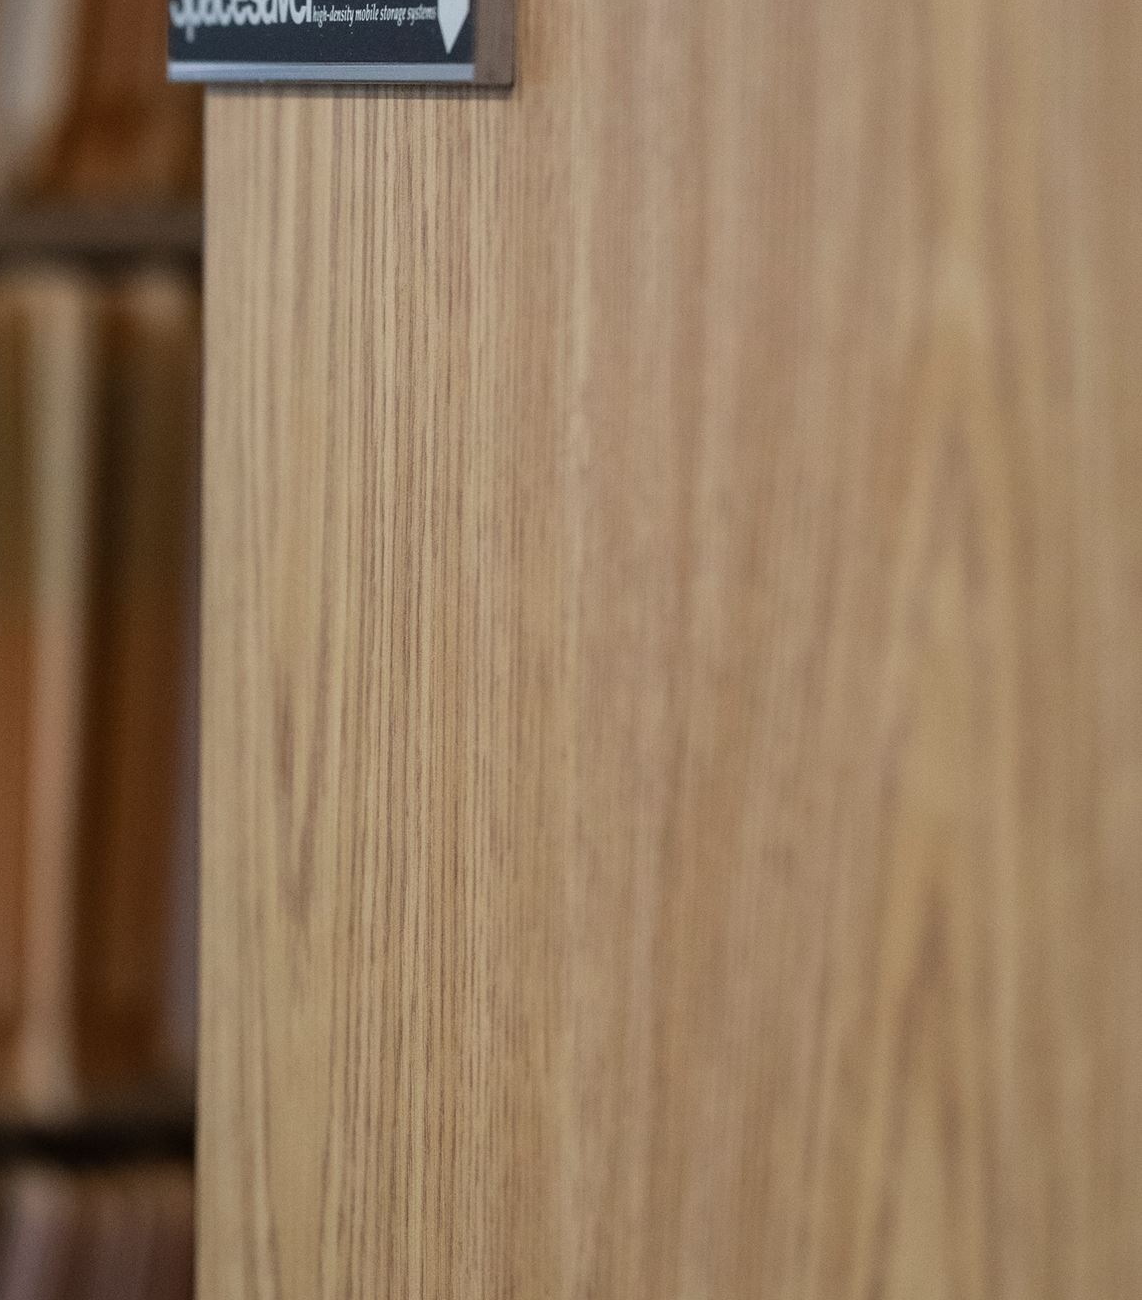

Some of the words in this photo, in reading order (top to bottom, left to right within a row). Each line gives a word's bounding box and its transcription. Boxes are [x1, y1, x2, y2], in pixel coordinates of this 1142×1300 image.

[312, 4, 354, 28] high-density
[355, 3, 379, 21] mobile
[379, 4, 407, 27] storage
[407, 3, 437, 26] systems
